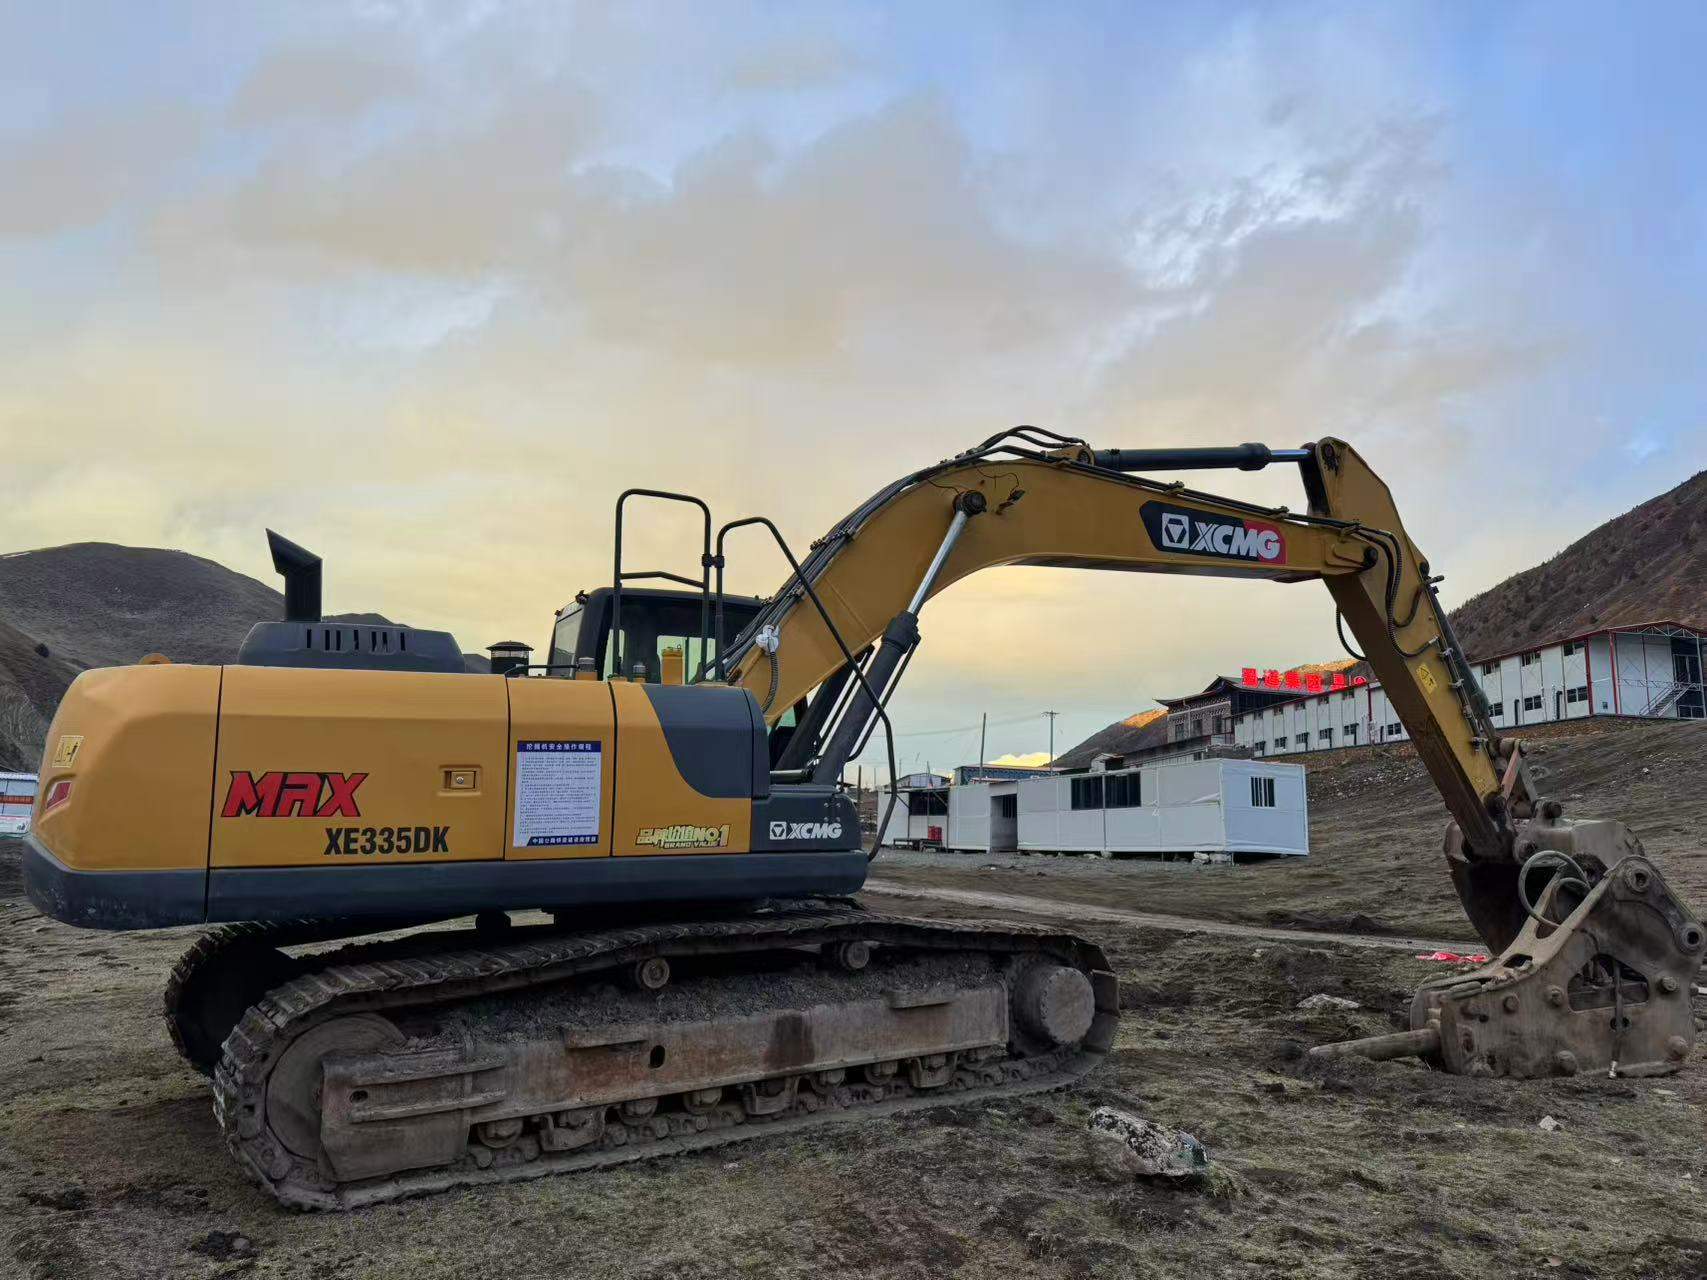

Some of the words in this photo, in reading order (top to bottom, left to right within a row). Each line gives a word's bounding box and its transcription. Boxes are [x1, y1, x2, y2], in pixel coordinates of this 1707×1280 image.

[1190, 521, 1280, 559] XCMG
[221, 771, 370, 817] MAX
[323, 826, 450, 856] XE335DK
[786, 822, 843, 840] XCMG
